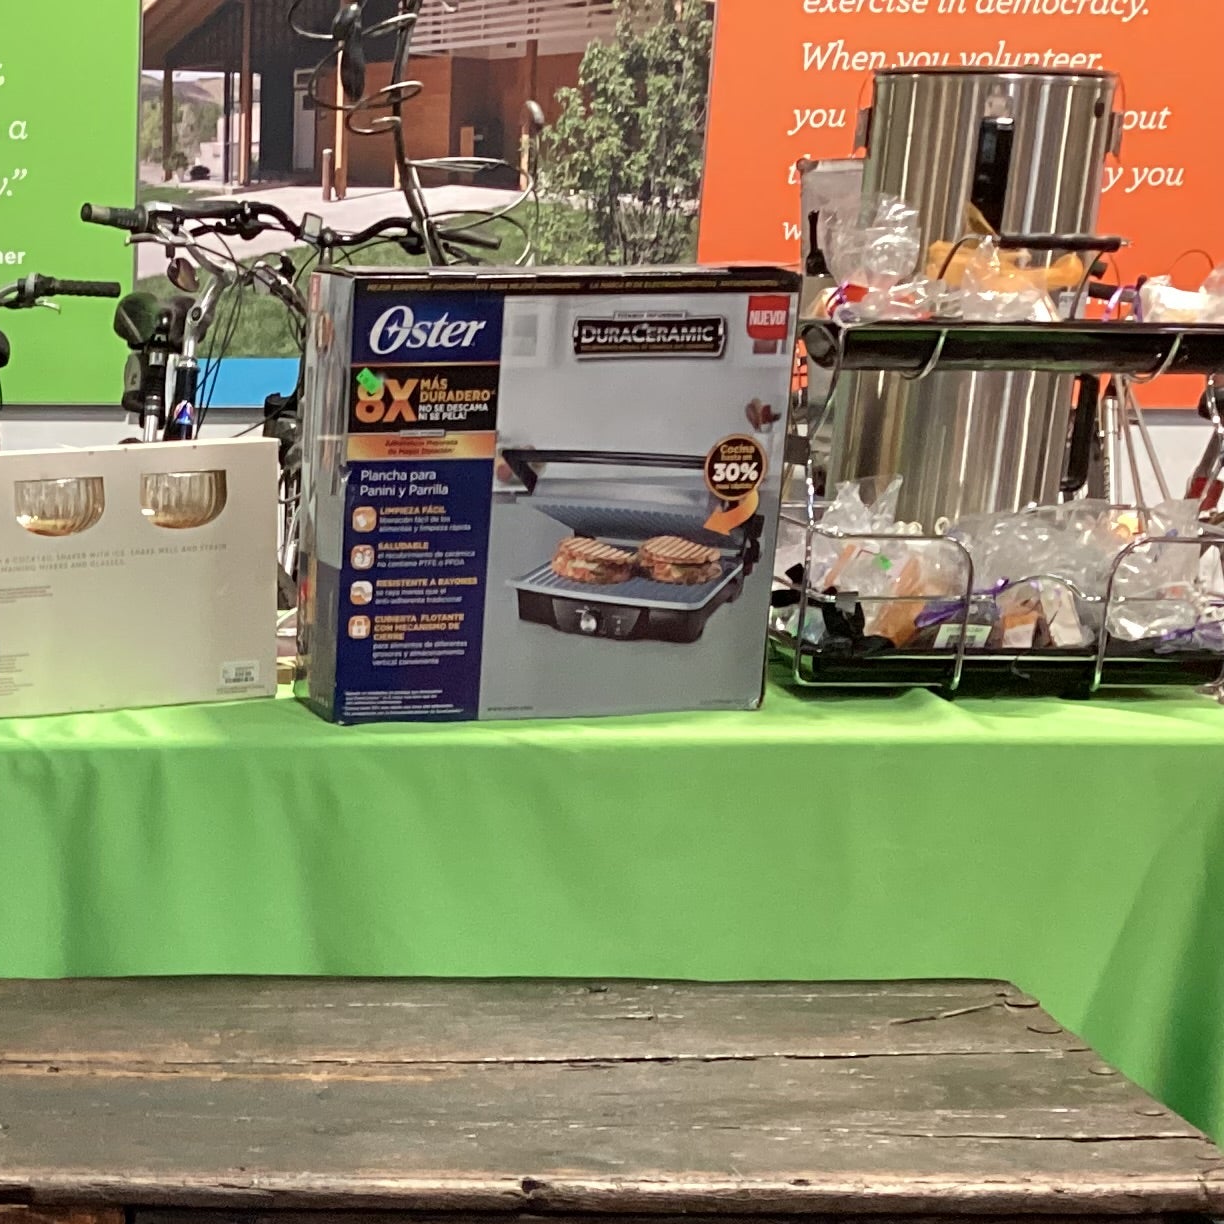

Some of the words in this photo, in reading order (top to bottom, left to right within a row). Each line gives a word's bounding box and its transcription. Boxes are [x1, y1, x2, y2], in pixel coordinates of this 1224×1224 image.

[803, 0, 927, 14] exercise
[937, 0, 966, 14] in
[975, 0, 1149, 22] democracy.
[802, 40, 886, 71] When
[889, 51, 951, 68] you
[8, 119, 28, 140] a
[787, 109, 846, 136] you
[1123, 107, 1172, 130] out
[1125, 167, 1184, 193] you
[369, 306, 487, 354] Oster
[420, 374, 449, 390] MÁS
[355, 376, 419, 424] 8X
[418, 404, 432, 413] NO
[434, 404, 445, 412] SE
[446, 403, 488, 412] DESCAMA
[418, 412, 428, 420] NI
[429, 412, 440, 420] SE
[720, 444, 755, 454] Cocina
[360, 469, 407, 481] Plancha
[409, 471, 436, 482] para
[712, 462, 758, 482] 30%
[360, 485, 395, 496] Panini
[398, 486, 406, 498] y
[408, 484, 449, 496] Parrilla
